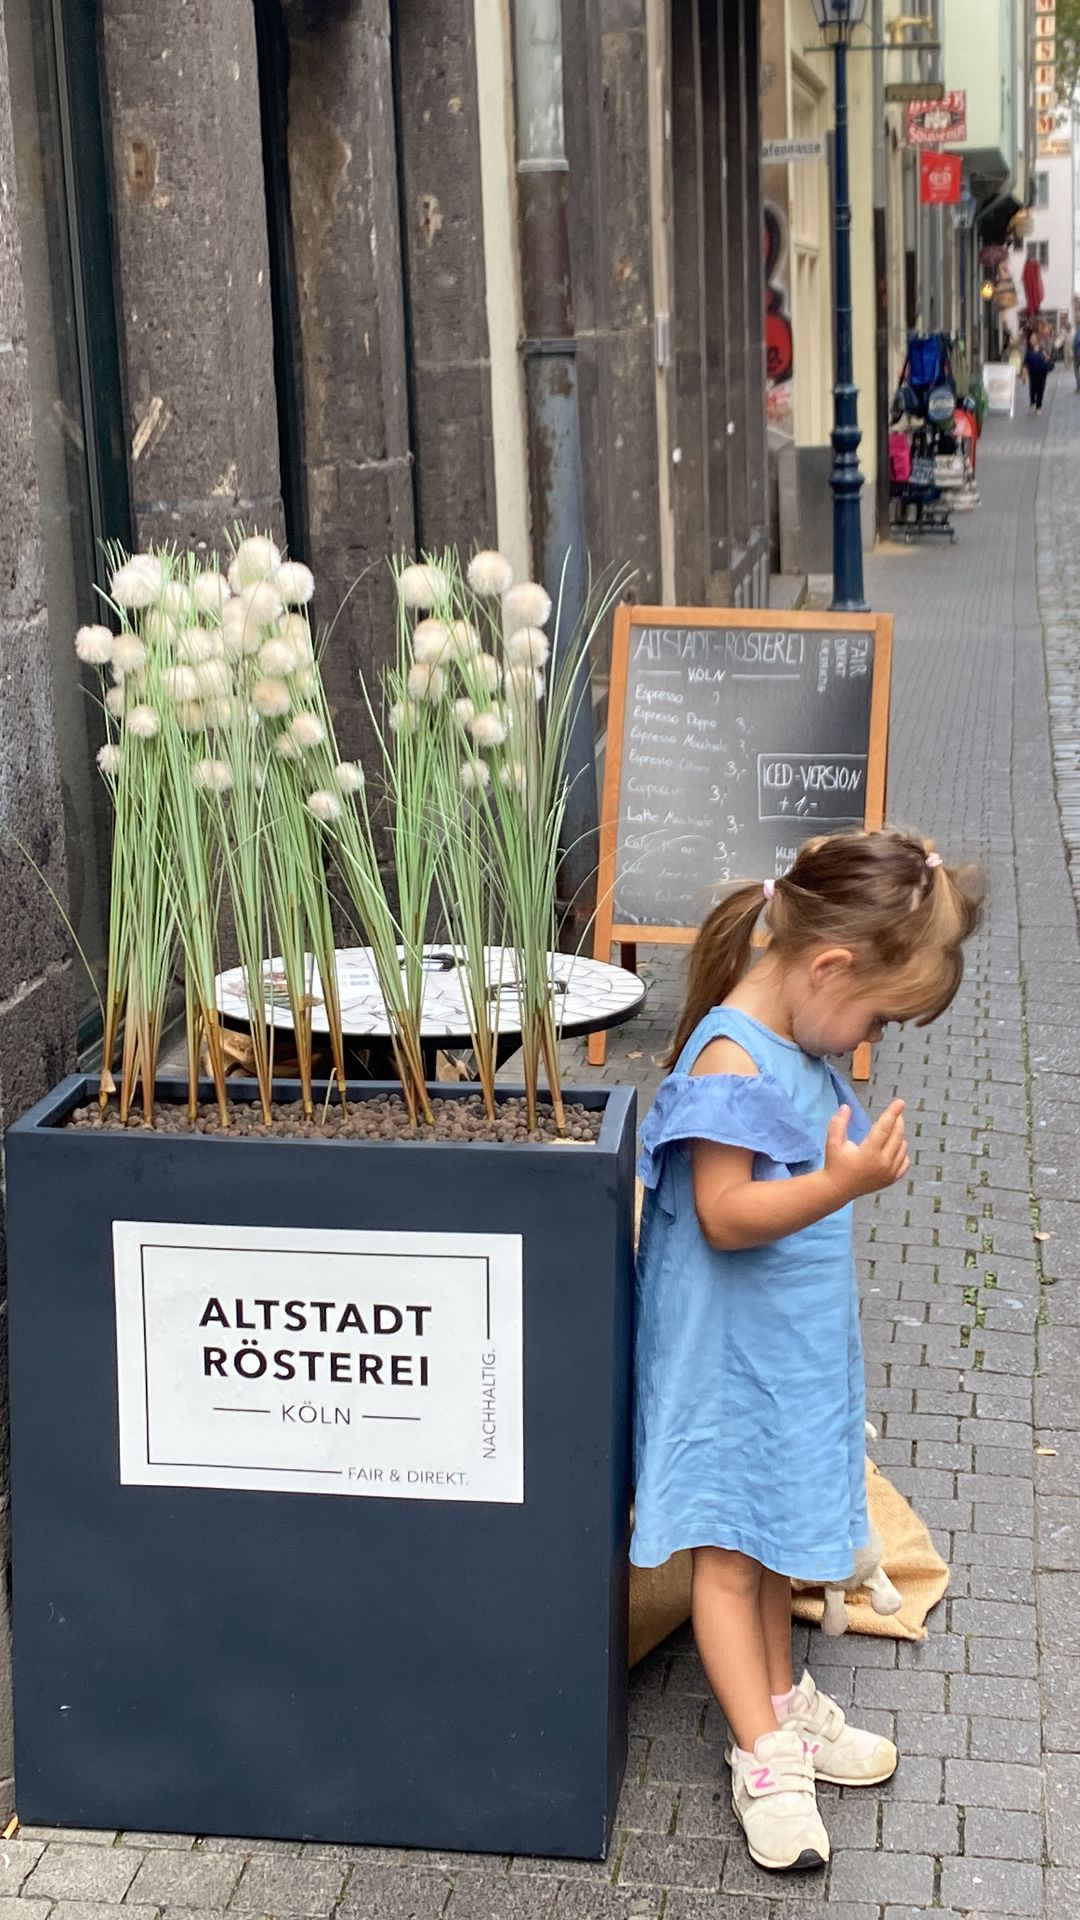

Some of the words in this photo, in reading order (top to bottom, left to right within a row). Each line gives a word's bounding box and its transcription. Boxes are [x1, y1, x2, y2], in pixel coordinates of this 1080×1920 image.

[635, 684, 684, 704] Espresso
[199, 1296, 432, 1338] ALTSTADT
[202, 1338, 430, 1387] RÖSTEREI
[281, 1400, 352, 1426] KÖLN
[347, 1467, 384, 1483] FAIR
[389, 1468, 401, 1482] &
